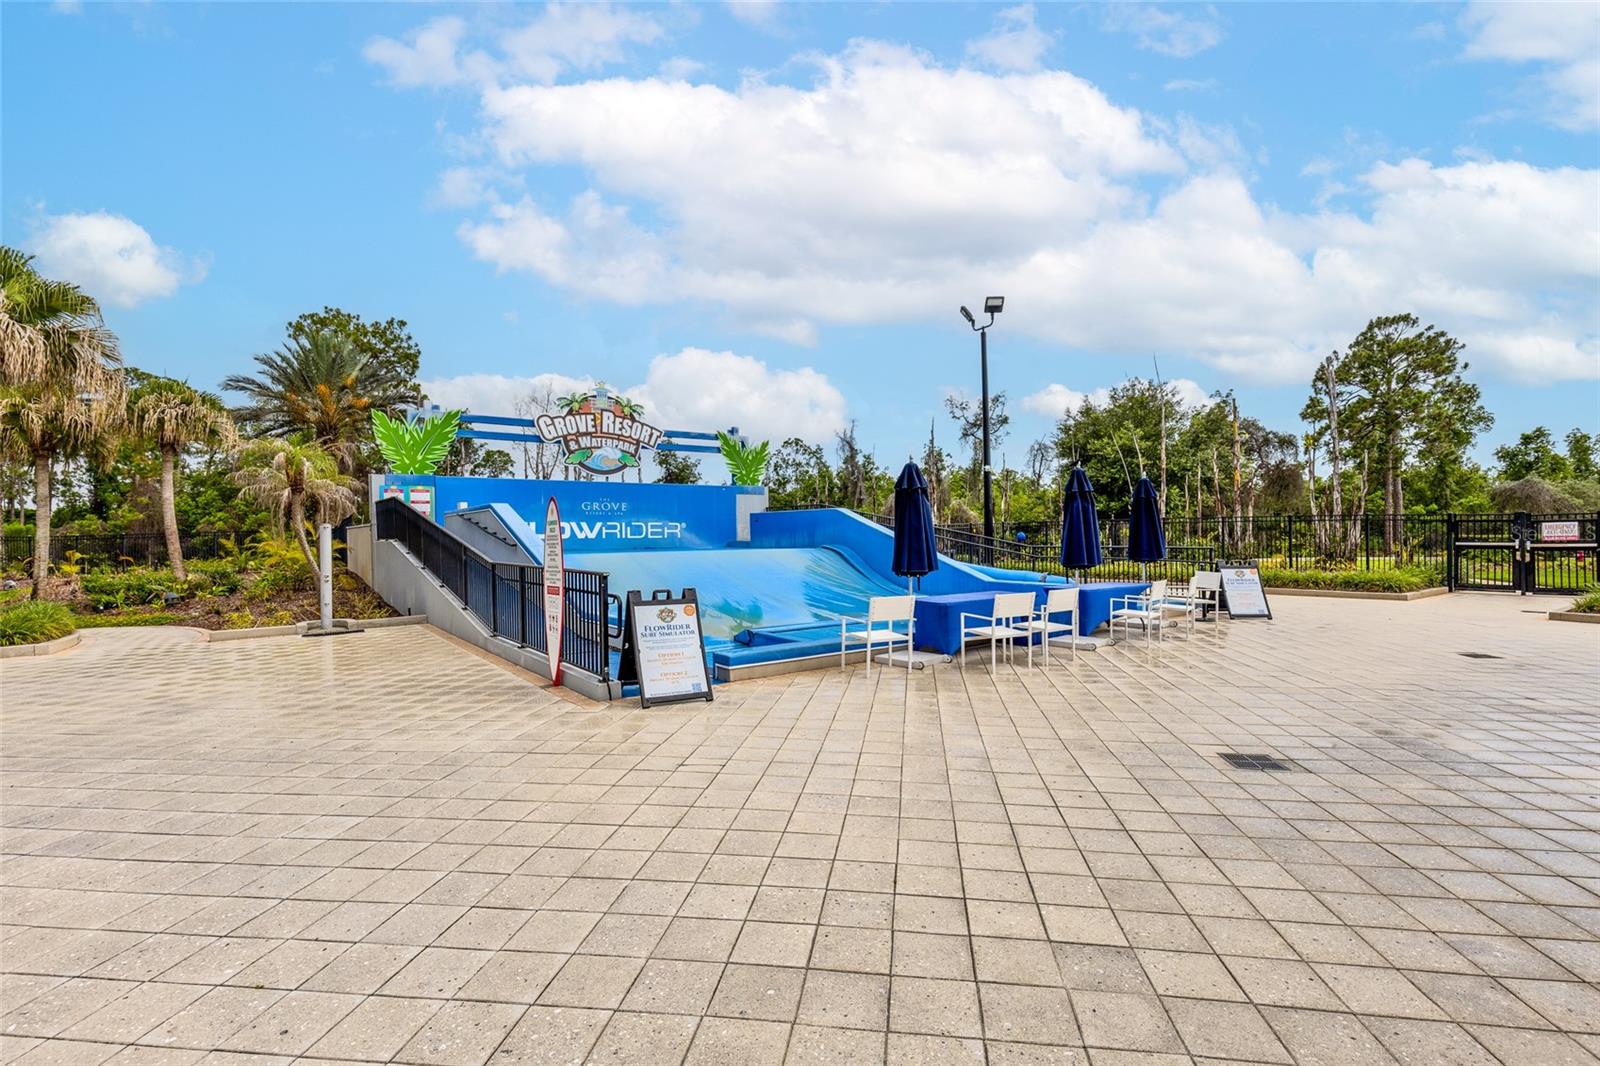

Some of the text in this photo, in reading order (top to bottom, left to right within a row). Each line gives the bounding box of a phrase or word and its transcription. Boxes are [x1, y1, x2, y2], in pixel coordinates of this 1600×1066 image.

[537, 410, 662, 448] GROVE RESORT
[570, 435, 637, 454] & WATERPARK
[581, 501, 628, 511] GROVE
[658, 629, 695, 637] SIMULATOR
